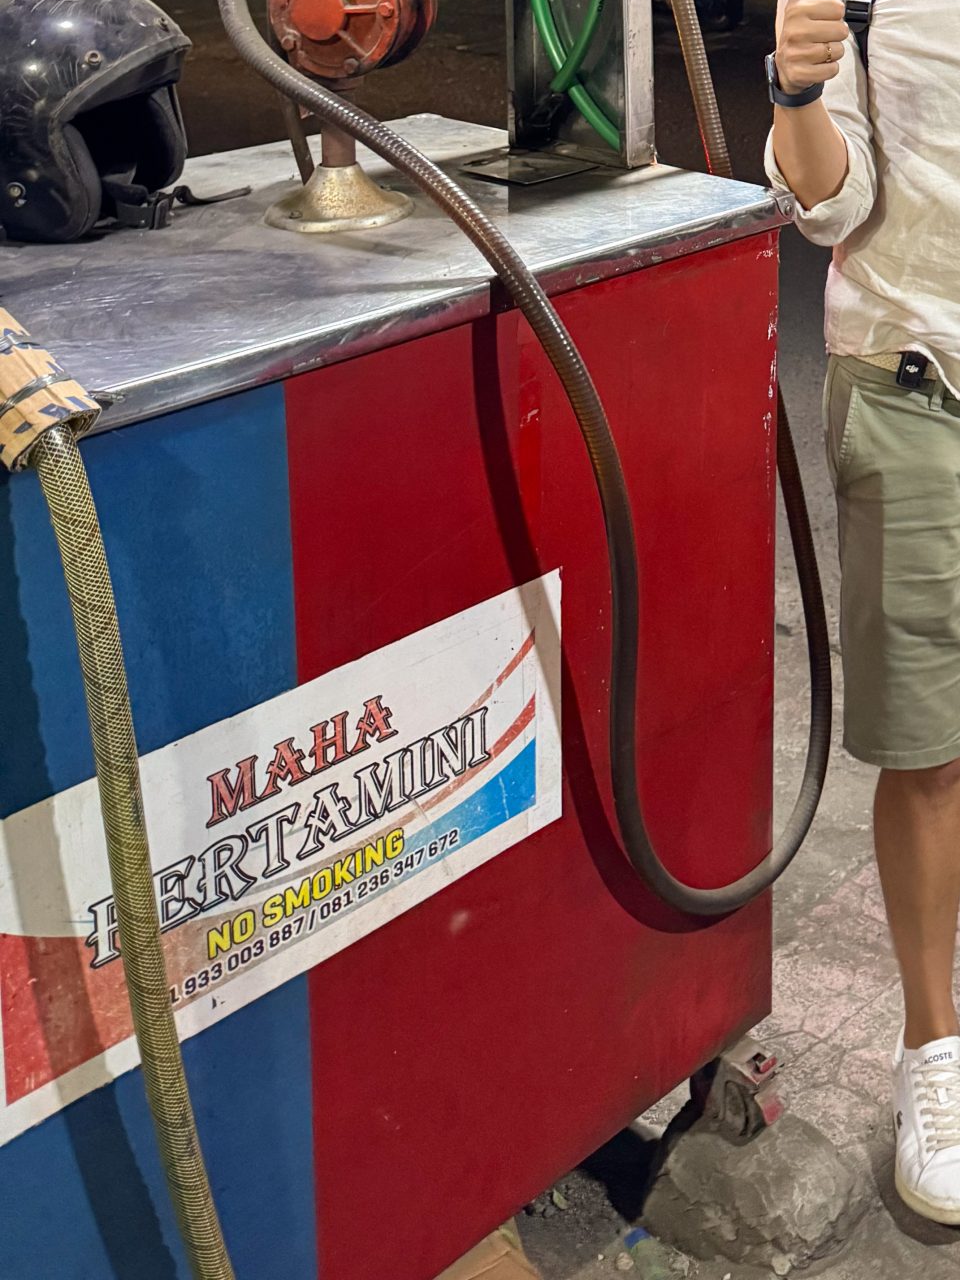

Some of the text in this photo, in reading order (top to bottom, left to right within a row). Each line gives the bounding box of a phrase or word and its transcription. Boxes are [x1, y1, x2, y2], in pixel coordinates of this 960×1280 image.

[206, 695, 398, 828] MAHA
[184, 962, 223, 996] 933
[227, 938, 265, 972] 003
[269, 917, 305, 949] 887
[320, 892, 354, 920] 081
[357, 870, 390, 900] 236
[393, 850, 425, 878] 347
[427, 828, 459, 858] 672
[207, 827, 405, 960] NO SMOKING
